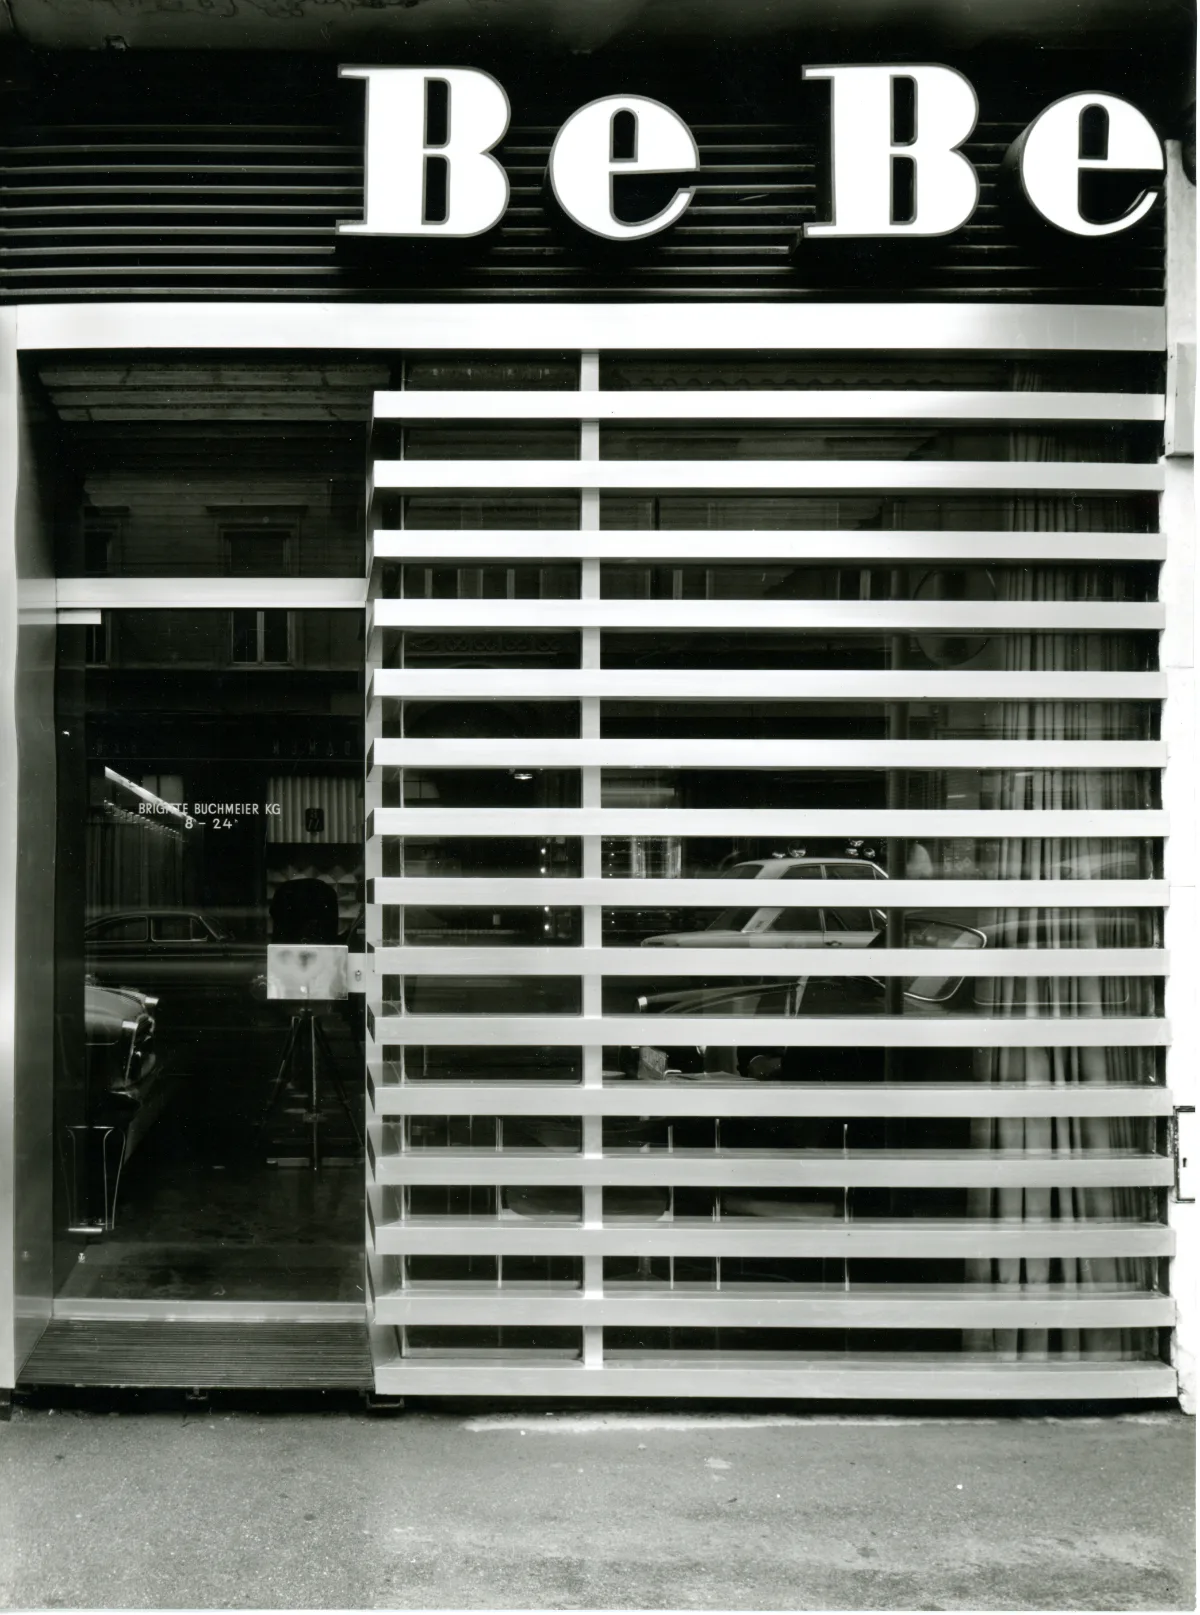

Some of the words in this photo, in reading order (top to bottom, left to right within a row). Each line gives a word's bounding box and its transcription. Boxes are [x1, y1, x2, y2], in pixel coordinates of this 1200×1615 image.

[337, 64, 700, 241] Be
[802, 62, 1165, 238] Be
[138, 802, 189, 815] BRIGTE
[194, 803, 260, 815] BUCHMEIER
[265, 803, 281, 815] KG
